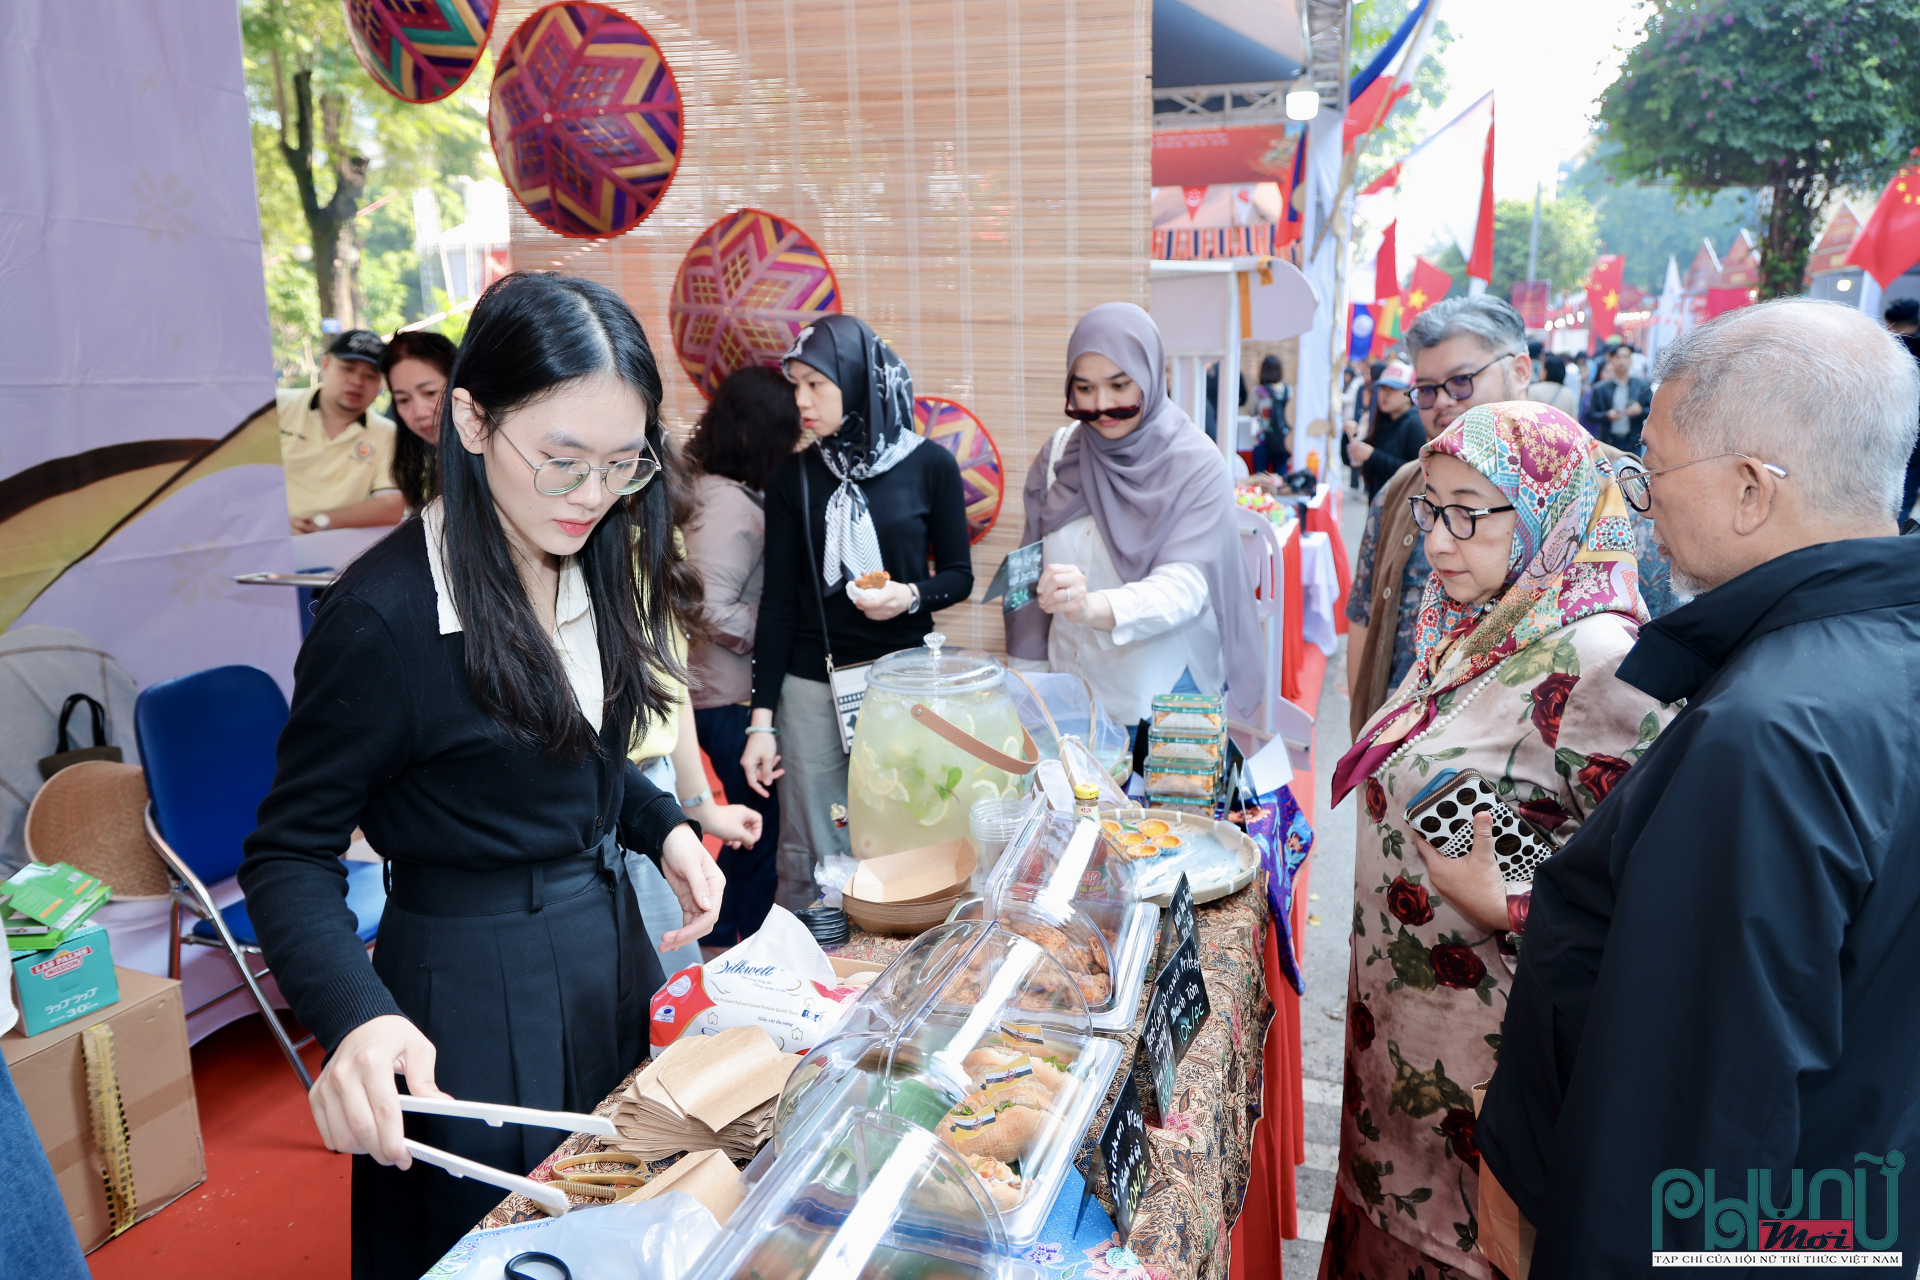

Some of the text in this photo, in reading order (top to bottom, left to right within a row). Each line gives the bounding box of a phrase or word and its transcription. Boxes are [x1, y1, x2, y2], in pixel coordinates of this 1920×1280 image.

[1011, 586, 1029, 608] 30K
[34, 947, 90, 974] LAS PALMS
[46, 960, 80, 975] MISSION
